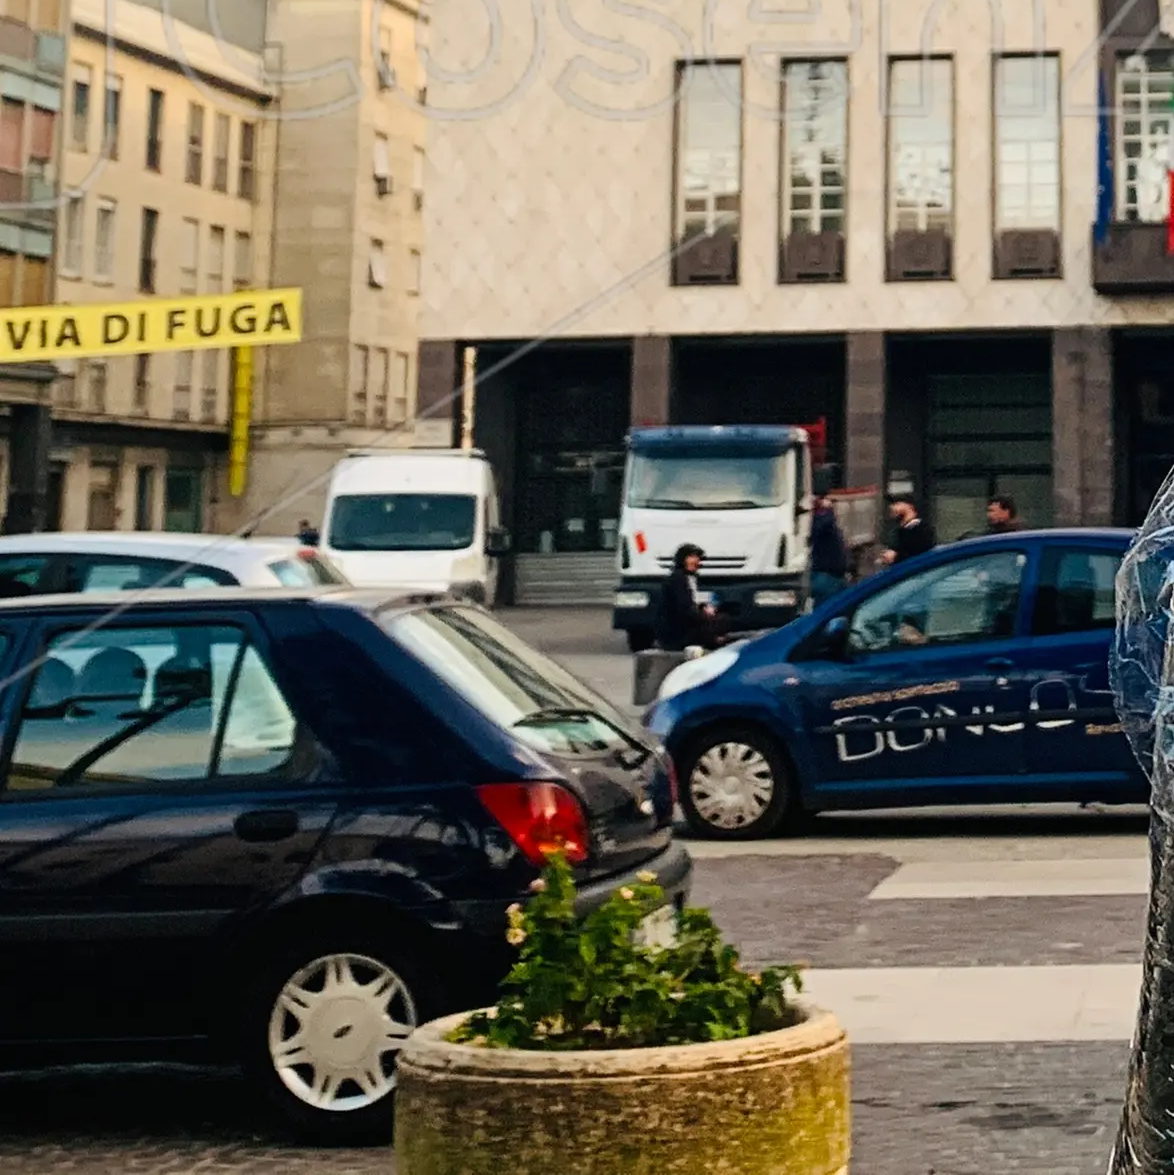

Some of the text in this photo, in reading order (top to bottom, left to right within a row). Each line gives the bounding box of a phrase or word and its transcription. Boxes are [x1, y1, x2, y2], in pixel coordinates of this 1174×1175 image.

[6, 301, 292, 351] VIA DI FUGA
